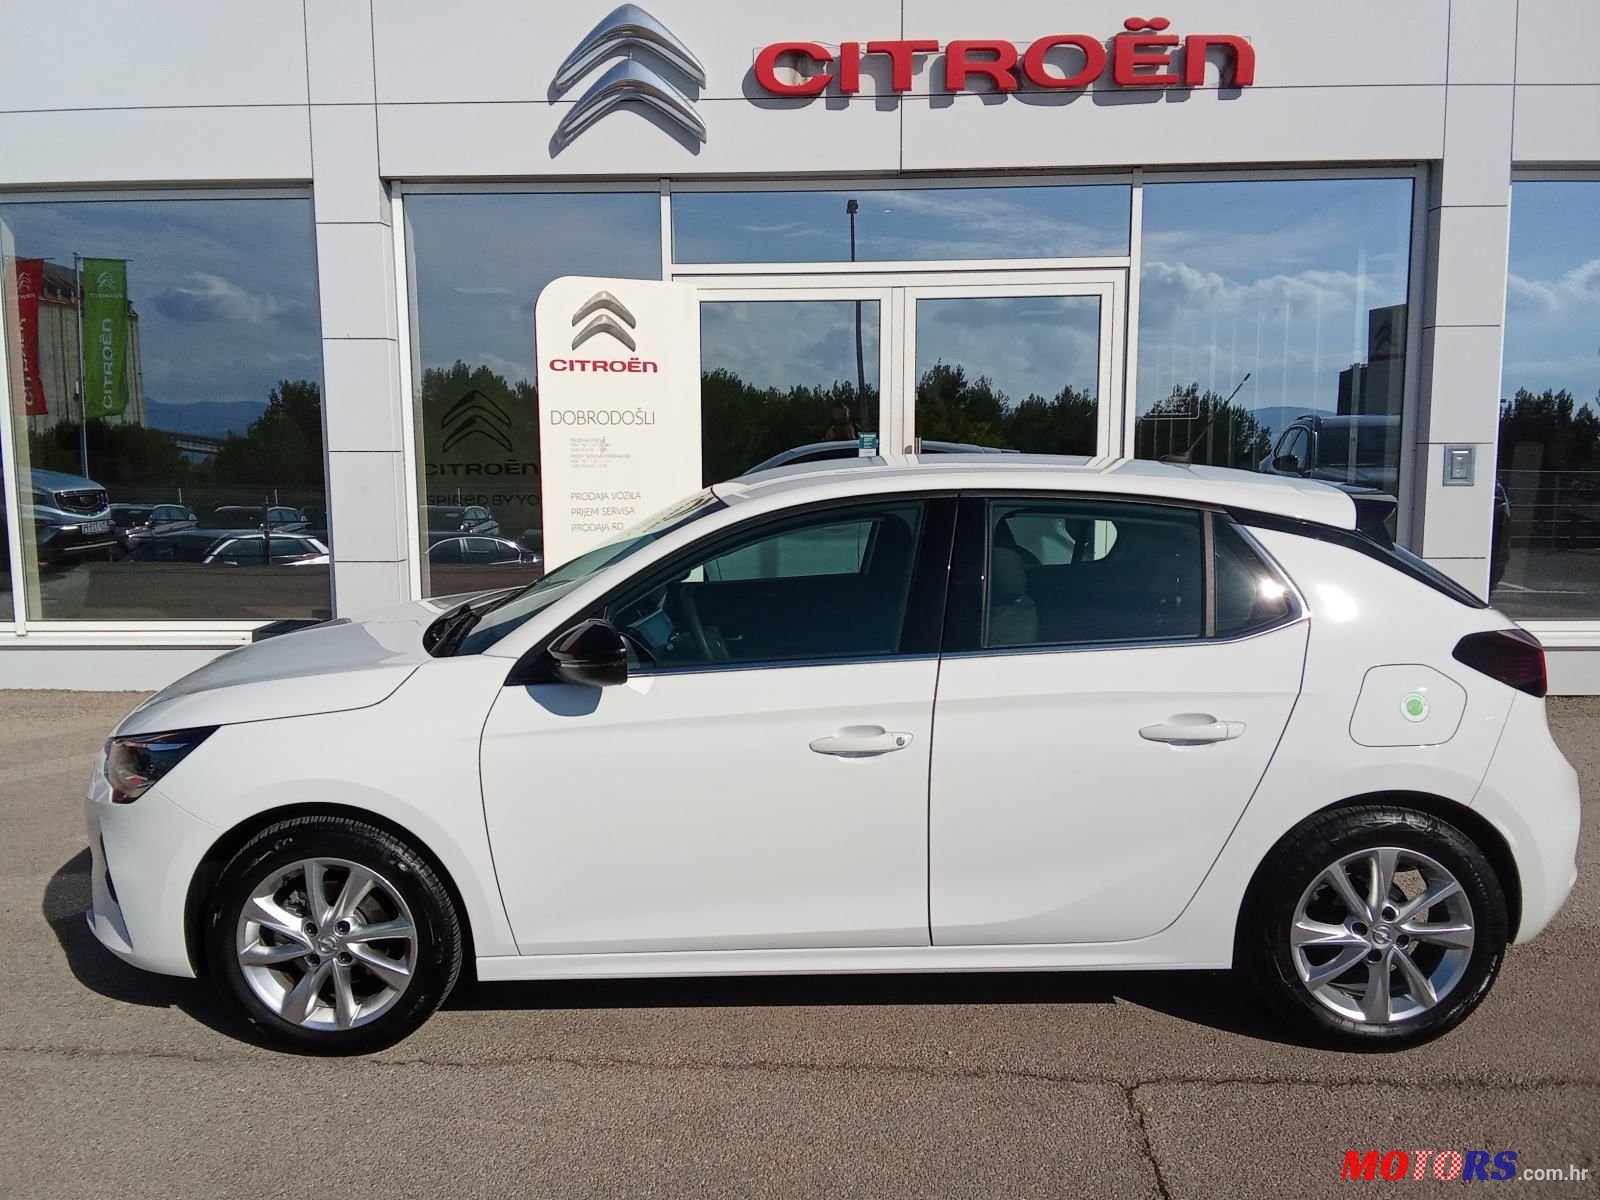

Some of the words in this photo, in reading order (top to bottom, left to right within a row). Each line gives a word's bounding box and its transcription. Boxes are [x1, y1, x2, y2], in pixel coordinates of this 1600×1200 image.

[550, 407, 655, 426] DOBRODOŠLI
[570, 491, 610, 502] PRODAJA
[611, 491, 642, 500] VOZILA
[571, 507, 599, 518] PRIJEM
[601, 506, 635, 516] SERVISA
[571, 523, 610, 532] PRODAJA
